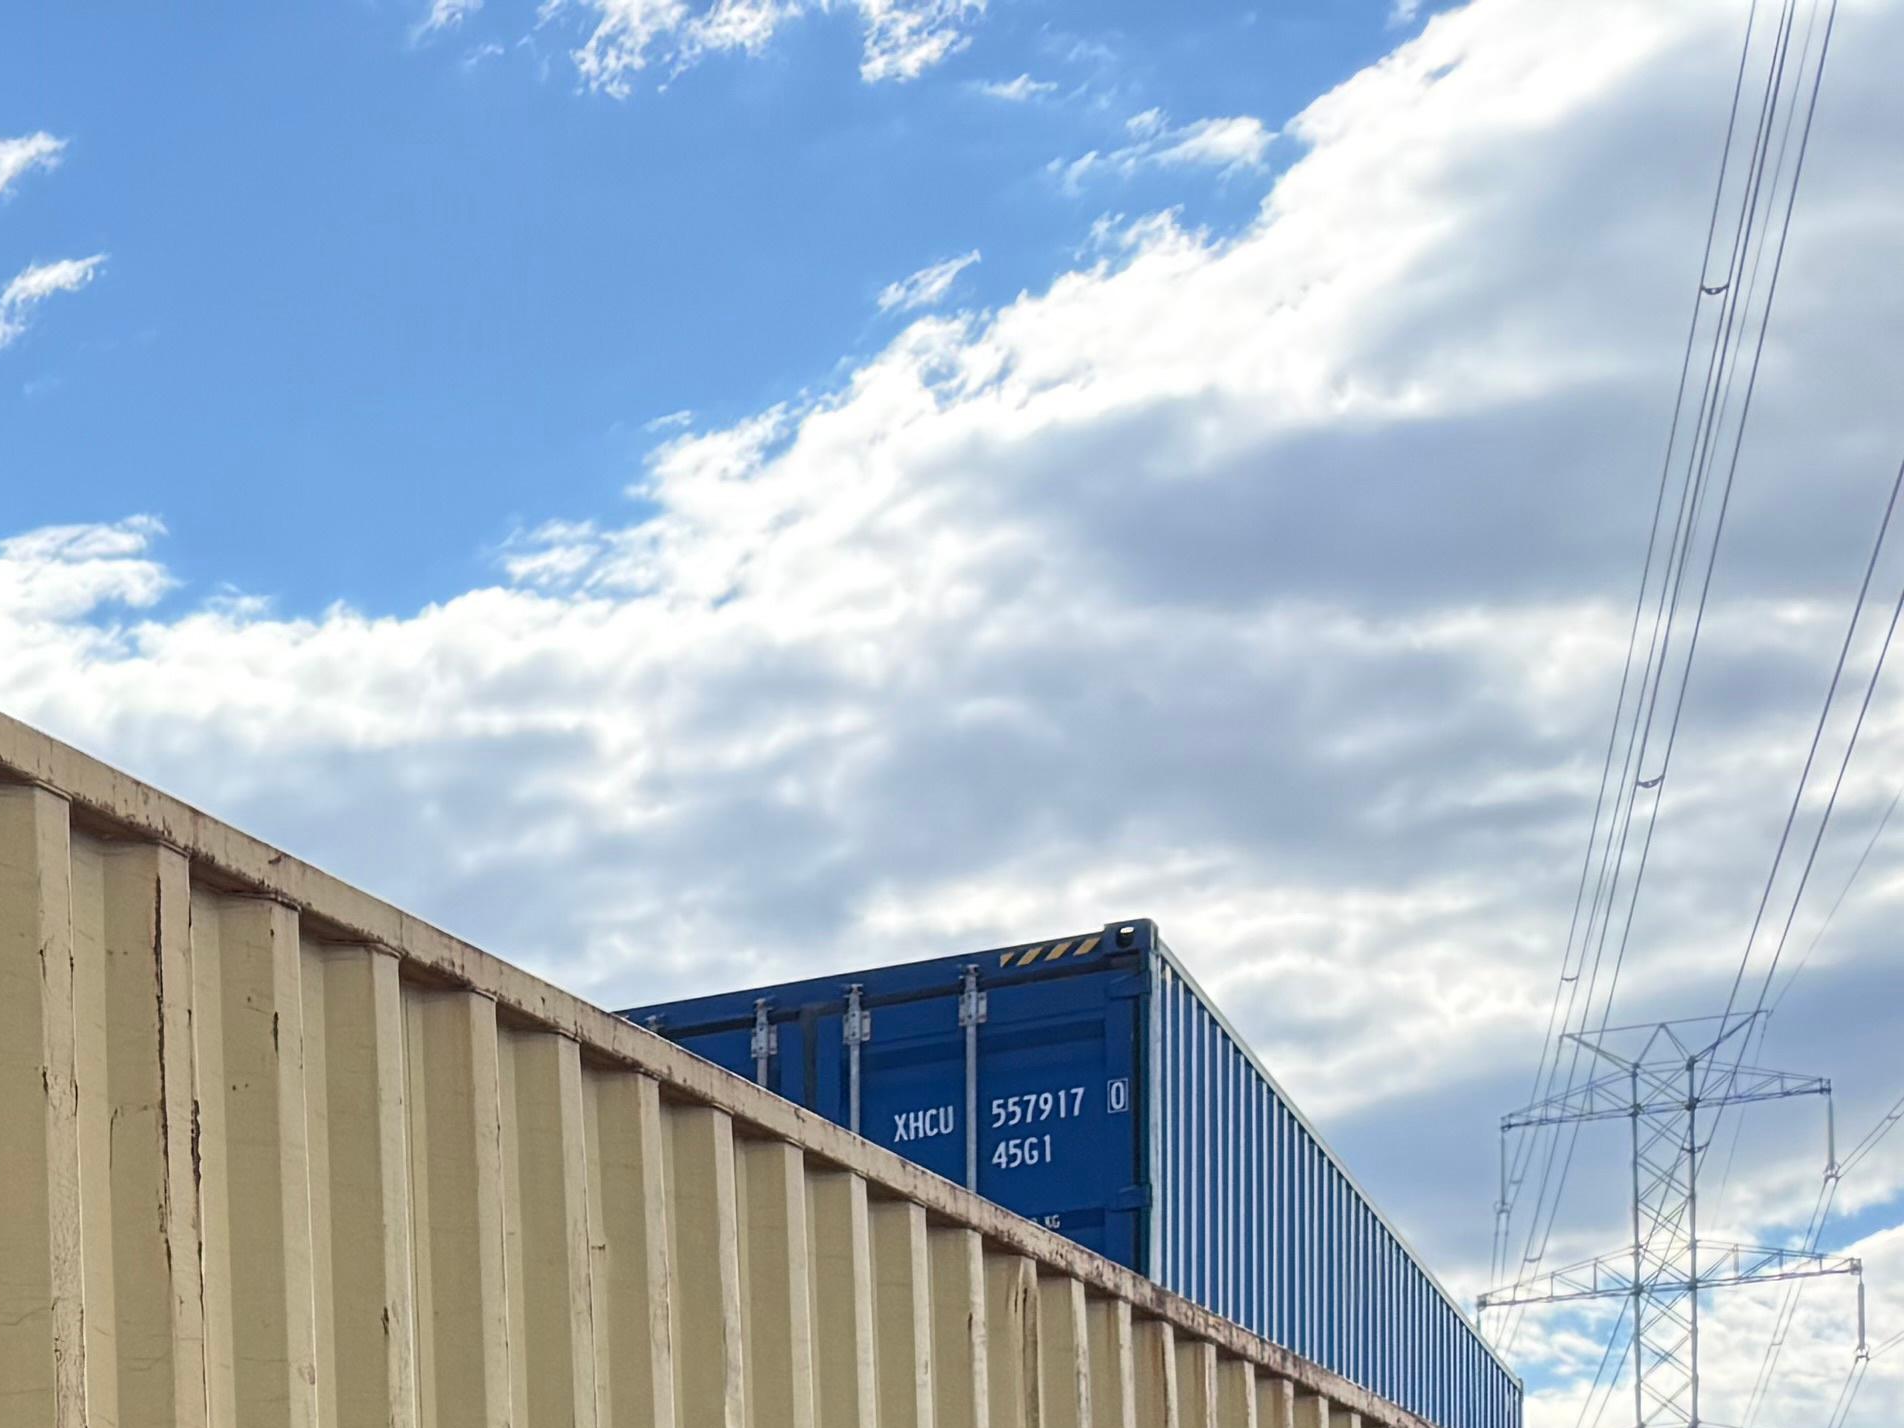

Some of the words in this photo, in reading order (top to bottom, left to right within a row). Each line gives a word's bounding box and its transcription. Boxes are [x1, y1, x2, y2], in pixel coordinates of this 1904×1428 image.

[894, 1105, 955, 1143] XHCU
[992, 1087, 1086, 1129] 557917
[992, 1134, 1052, 1170] 45G1
